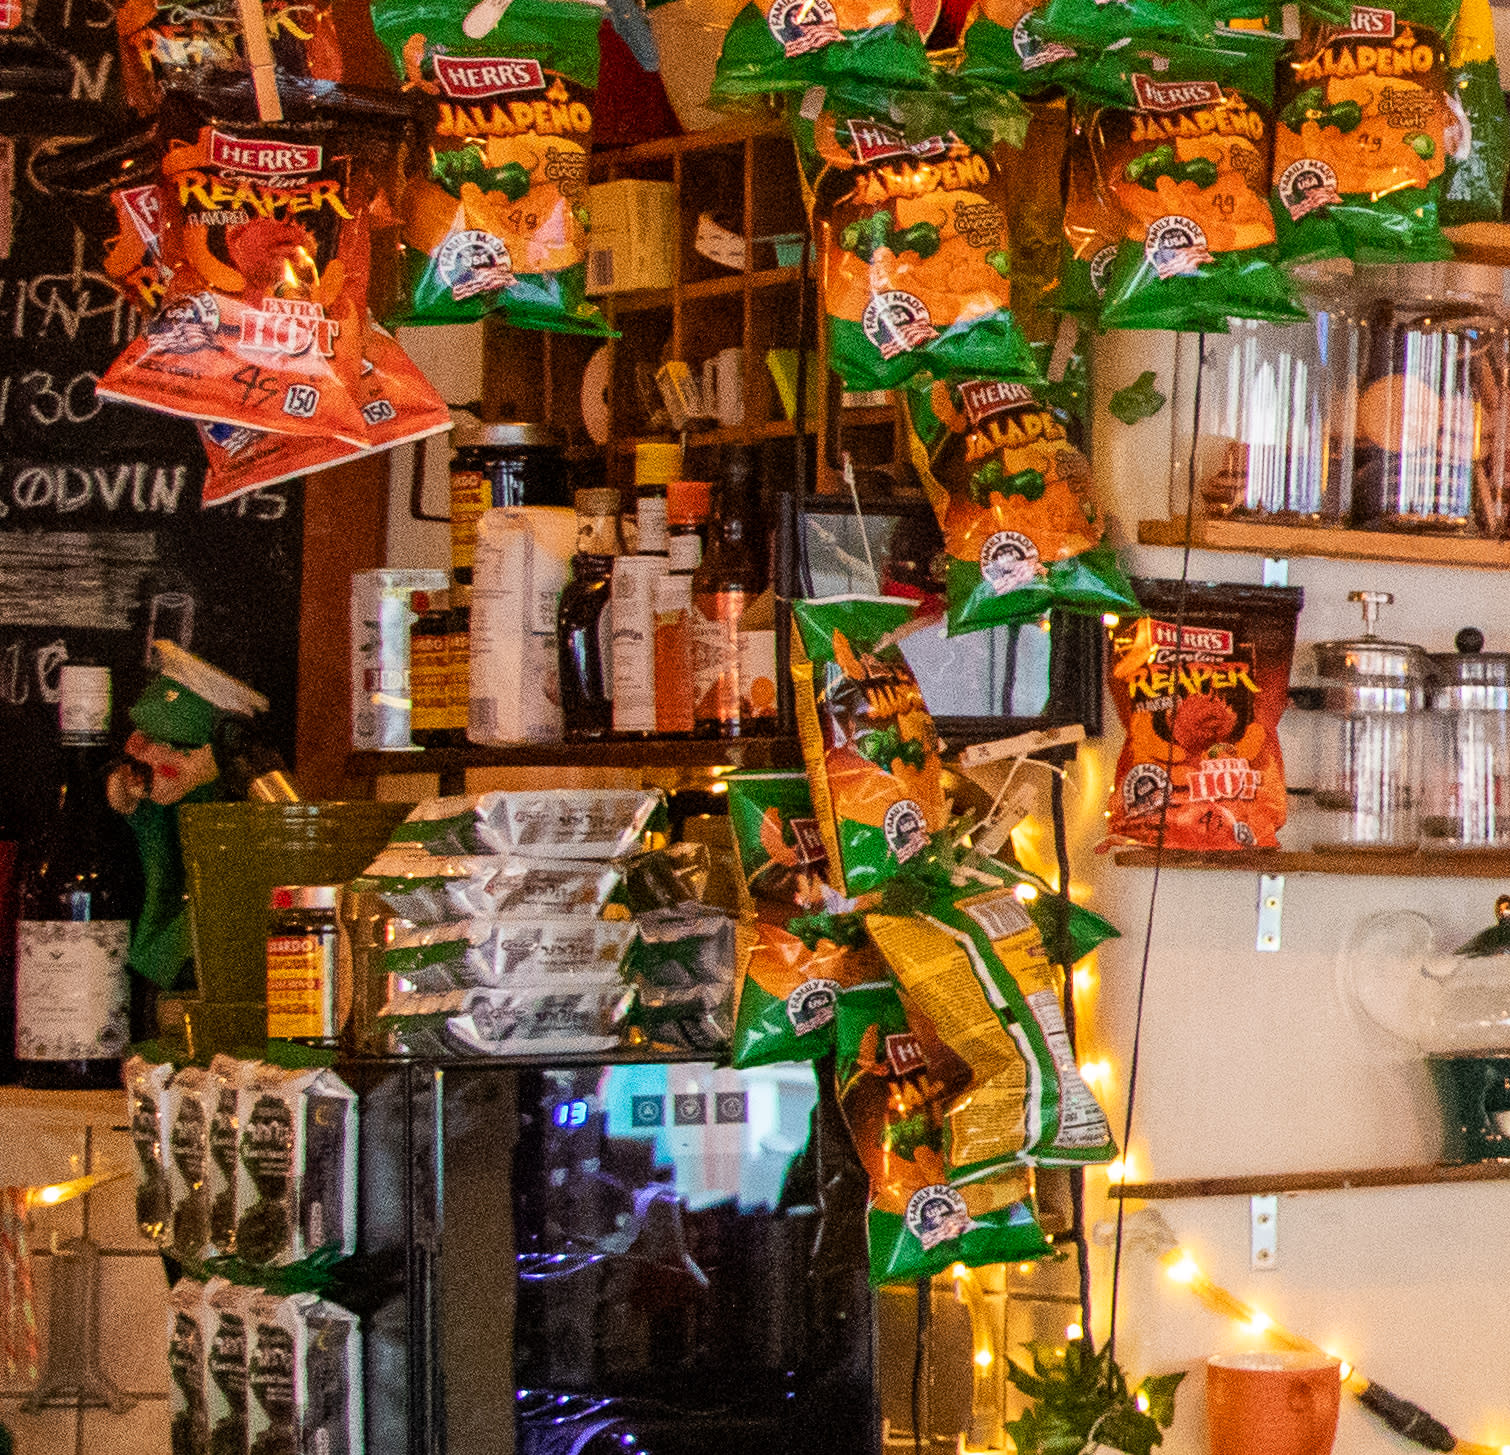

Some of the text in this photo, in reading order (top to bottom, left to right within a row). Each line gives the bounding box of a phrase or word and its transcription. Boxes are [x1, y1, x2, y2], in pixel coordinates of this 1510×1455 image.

[448, 64, 530, 88] HERR'S
[1144, 83, 1211, 106] HERR'S
[221, 146, 309, 170] HERR'S
[177, 172, 354, 220] REAPER
[286, 386, 317, 414] 150
[0, 462, 187, 518] ØDVIN
[555, 1101, 589, 1126] 13
